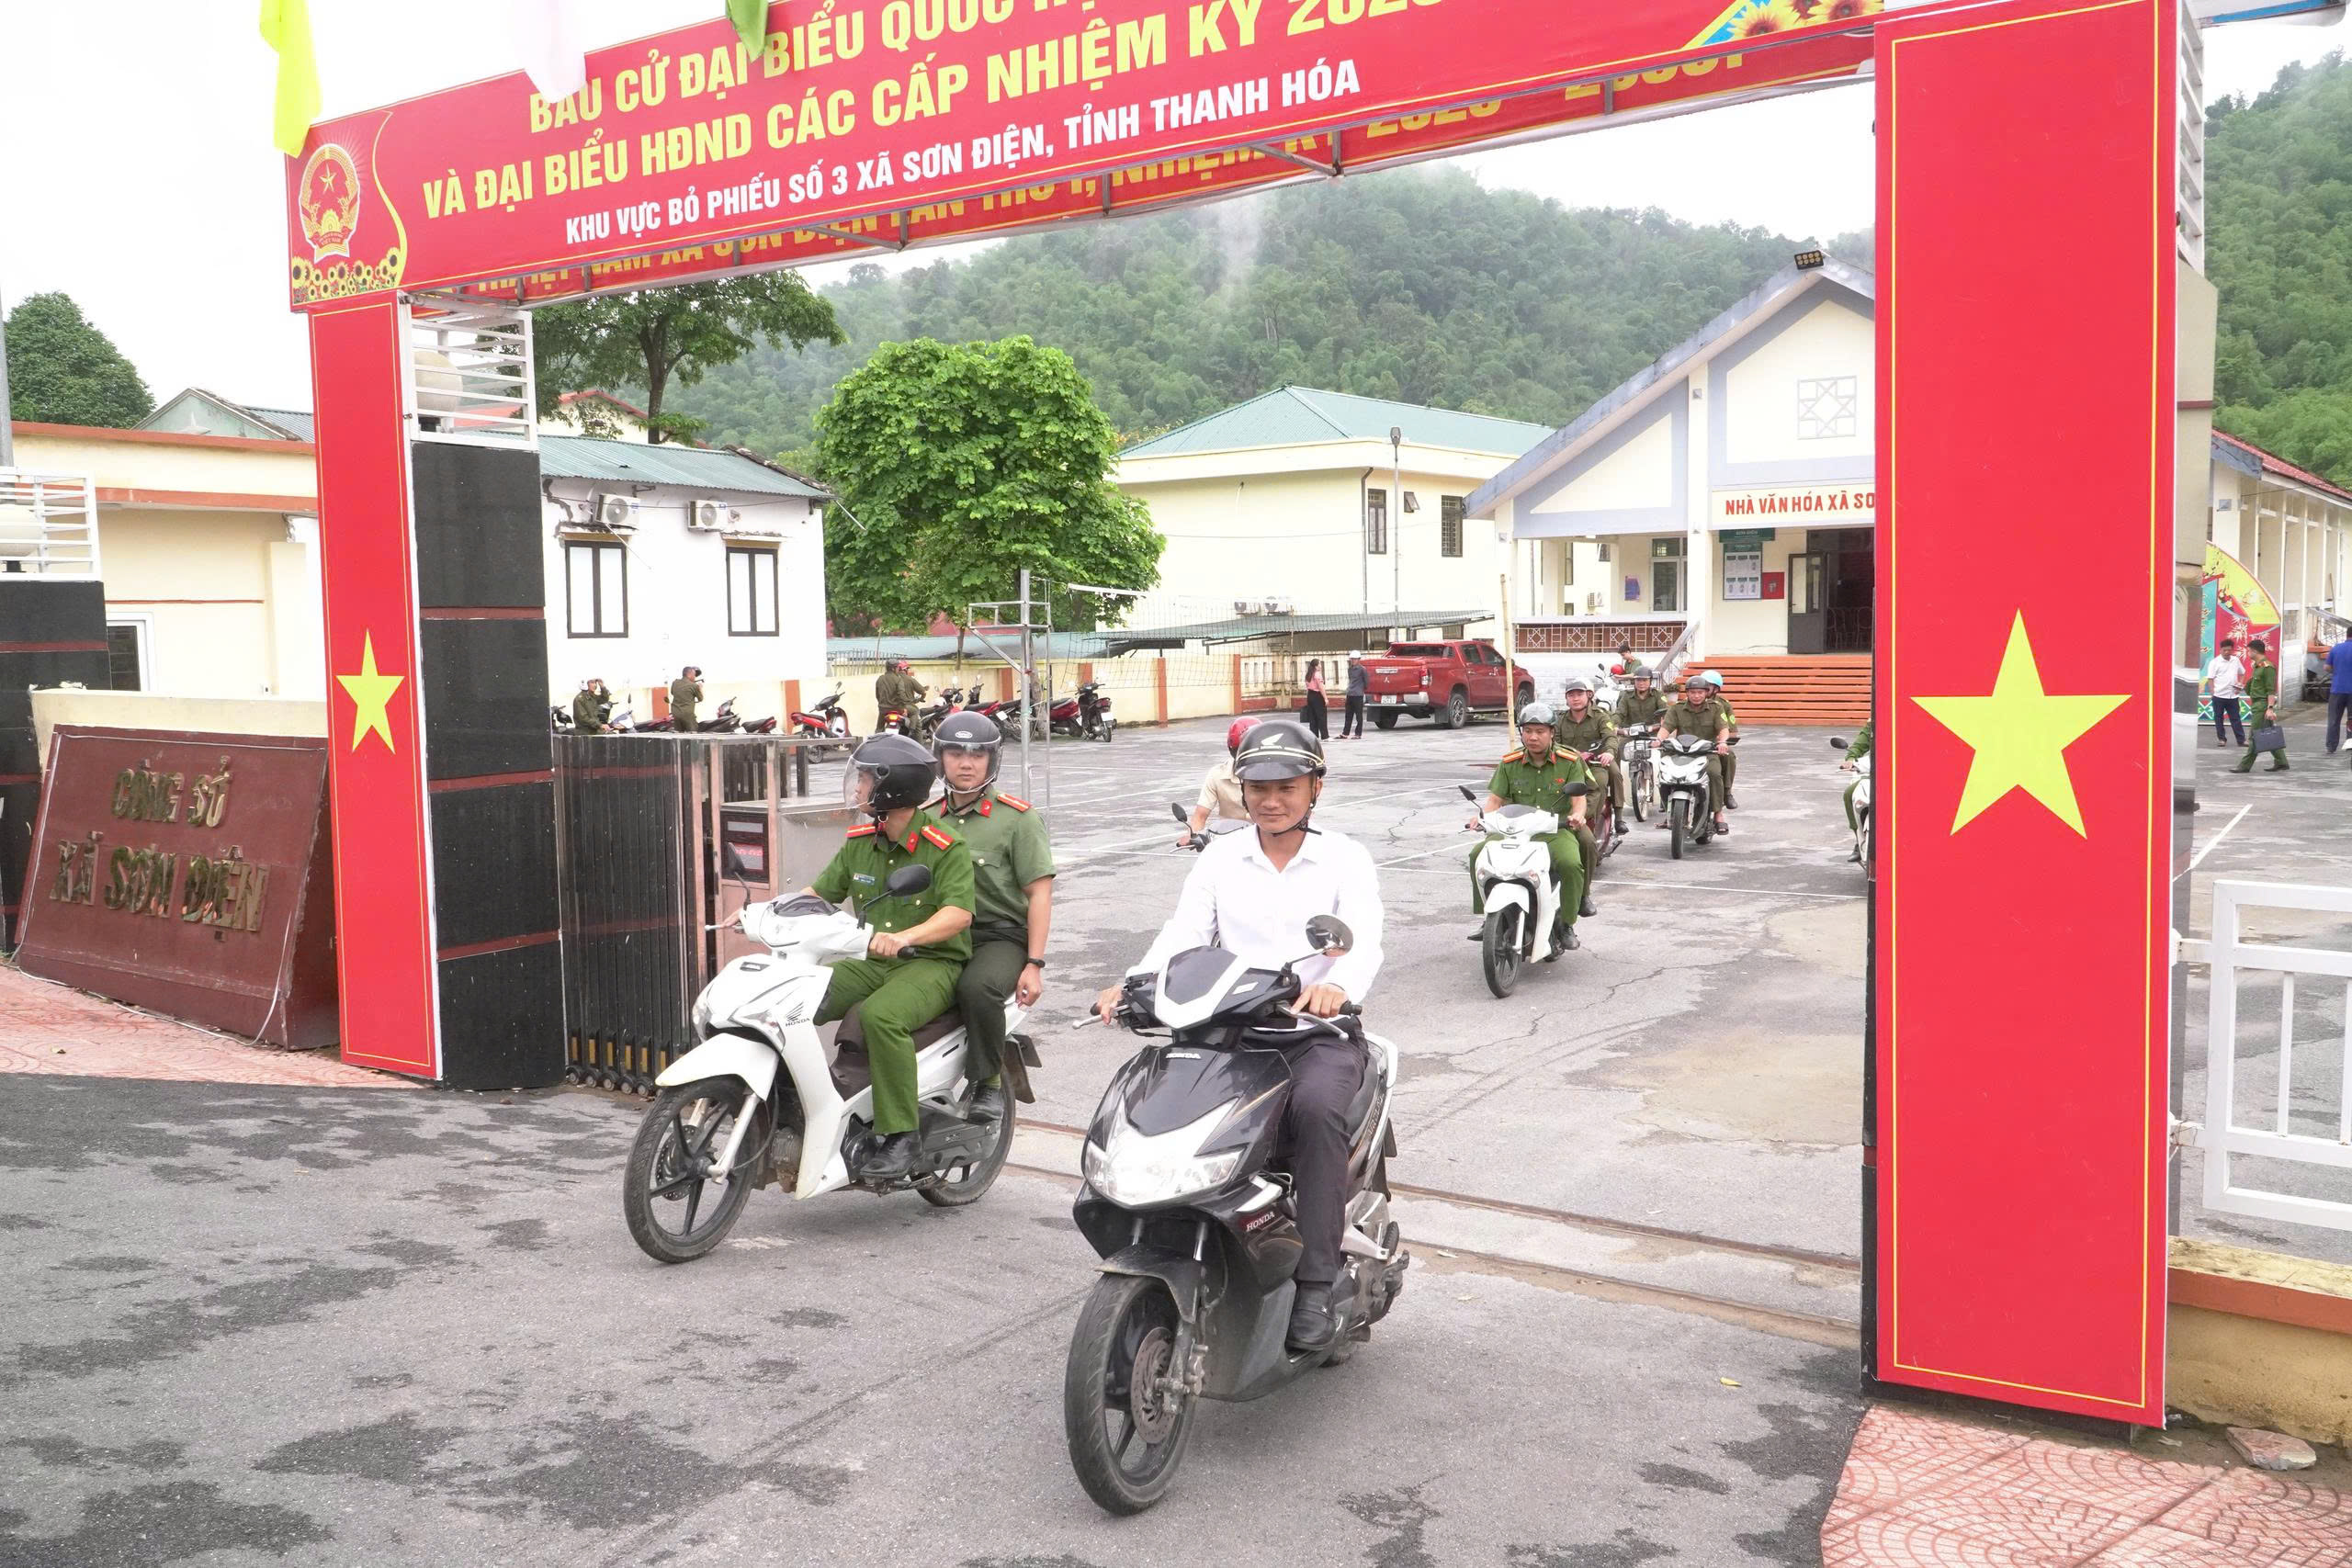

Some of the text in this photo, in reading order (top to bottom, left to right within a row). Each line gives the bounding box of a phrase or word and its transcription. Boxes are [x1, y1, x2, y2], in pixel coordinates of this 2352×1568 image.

[616, 49, 671, 112] CỬ
[679, 40, 749, 100] ĐẠI
[423, 169, 466, 219] VÀ
[474, 161, 533, 211] ĐẠI
[545, 128, 628, 196] BIỂU
[641, 114, 751, 175] HĐND
[767, 87, 855, 148] CÁC
[873, 51, 969, 127] CẤP
[988, 13, 1167, 104] NHIỆM
[566, 57, 1362, 244] KHU VỰC BỎ PHIẾU SỐ 3 XÃ SƠN ĐIỆN, TỈNH THANH HÓA
[1725, 494, 1755, 515] NHÀ
[1758, 493, 1788, 513] VĂN
[1792, 491, 1824, 513] HÓA
[1827, 490, 1849, 511] XÃ
[786, 1017, 810, 1027] HONDA
[1246, 1211, 1275, 1233] HONDA
